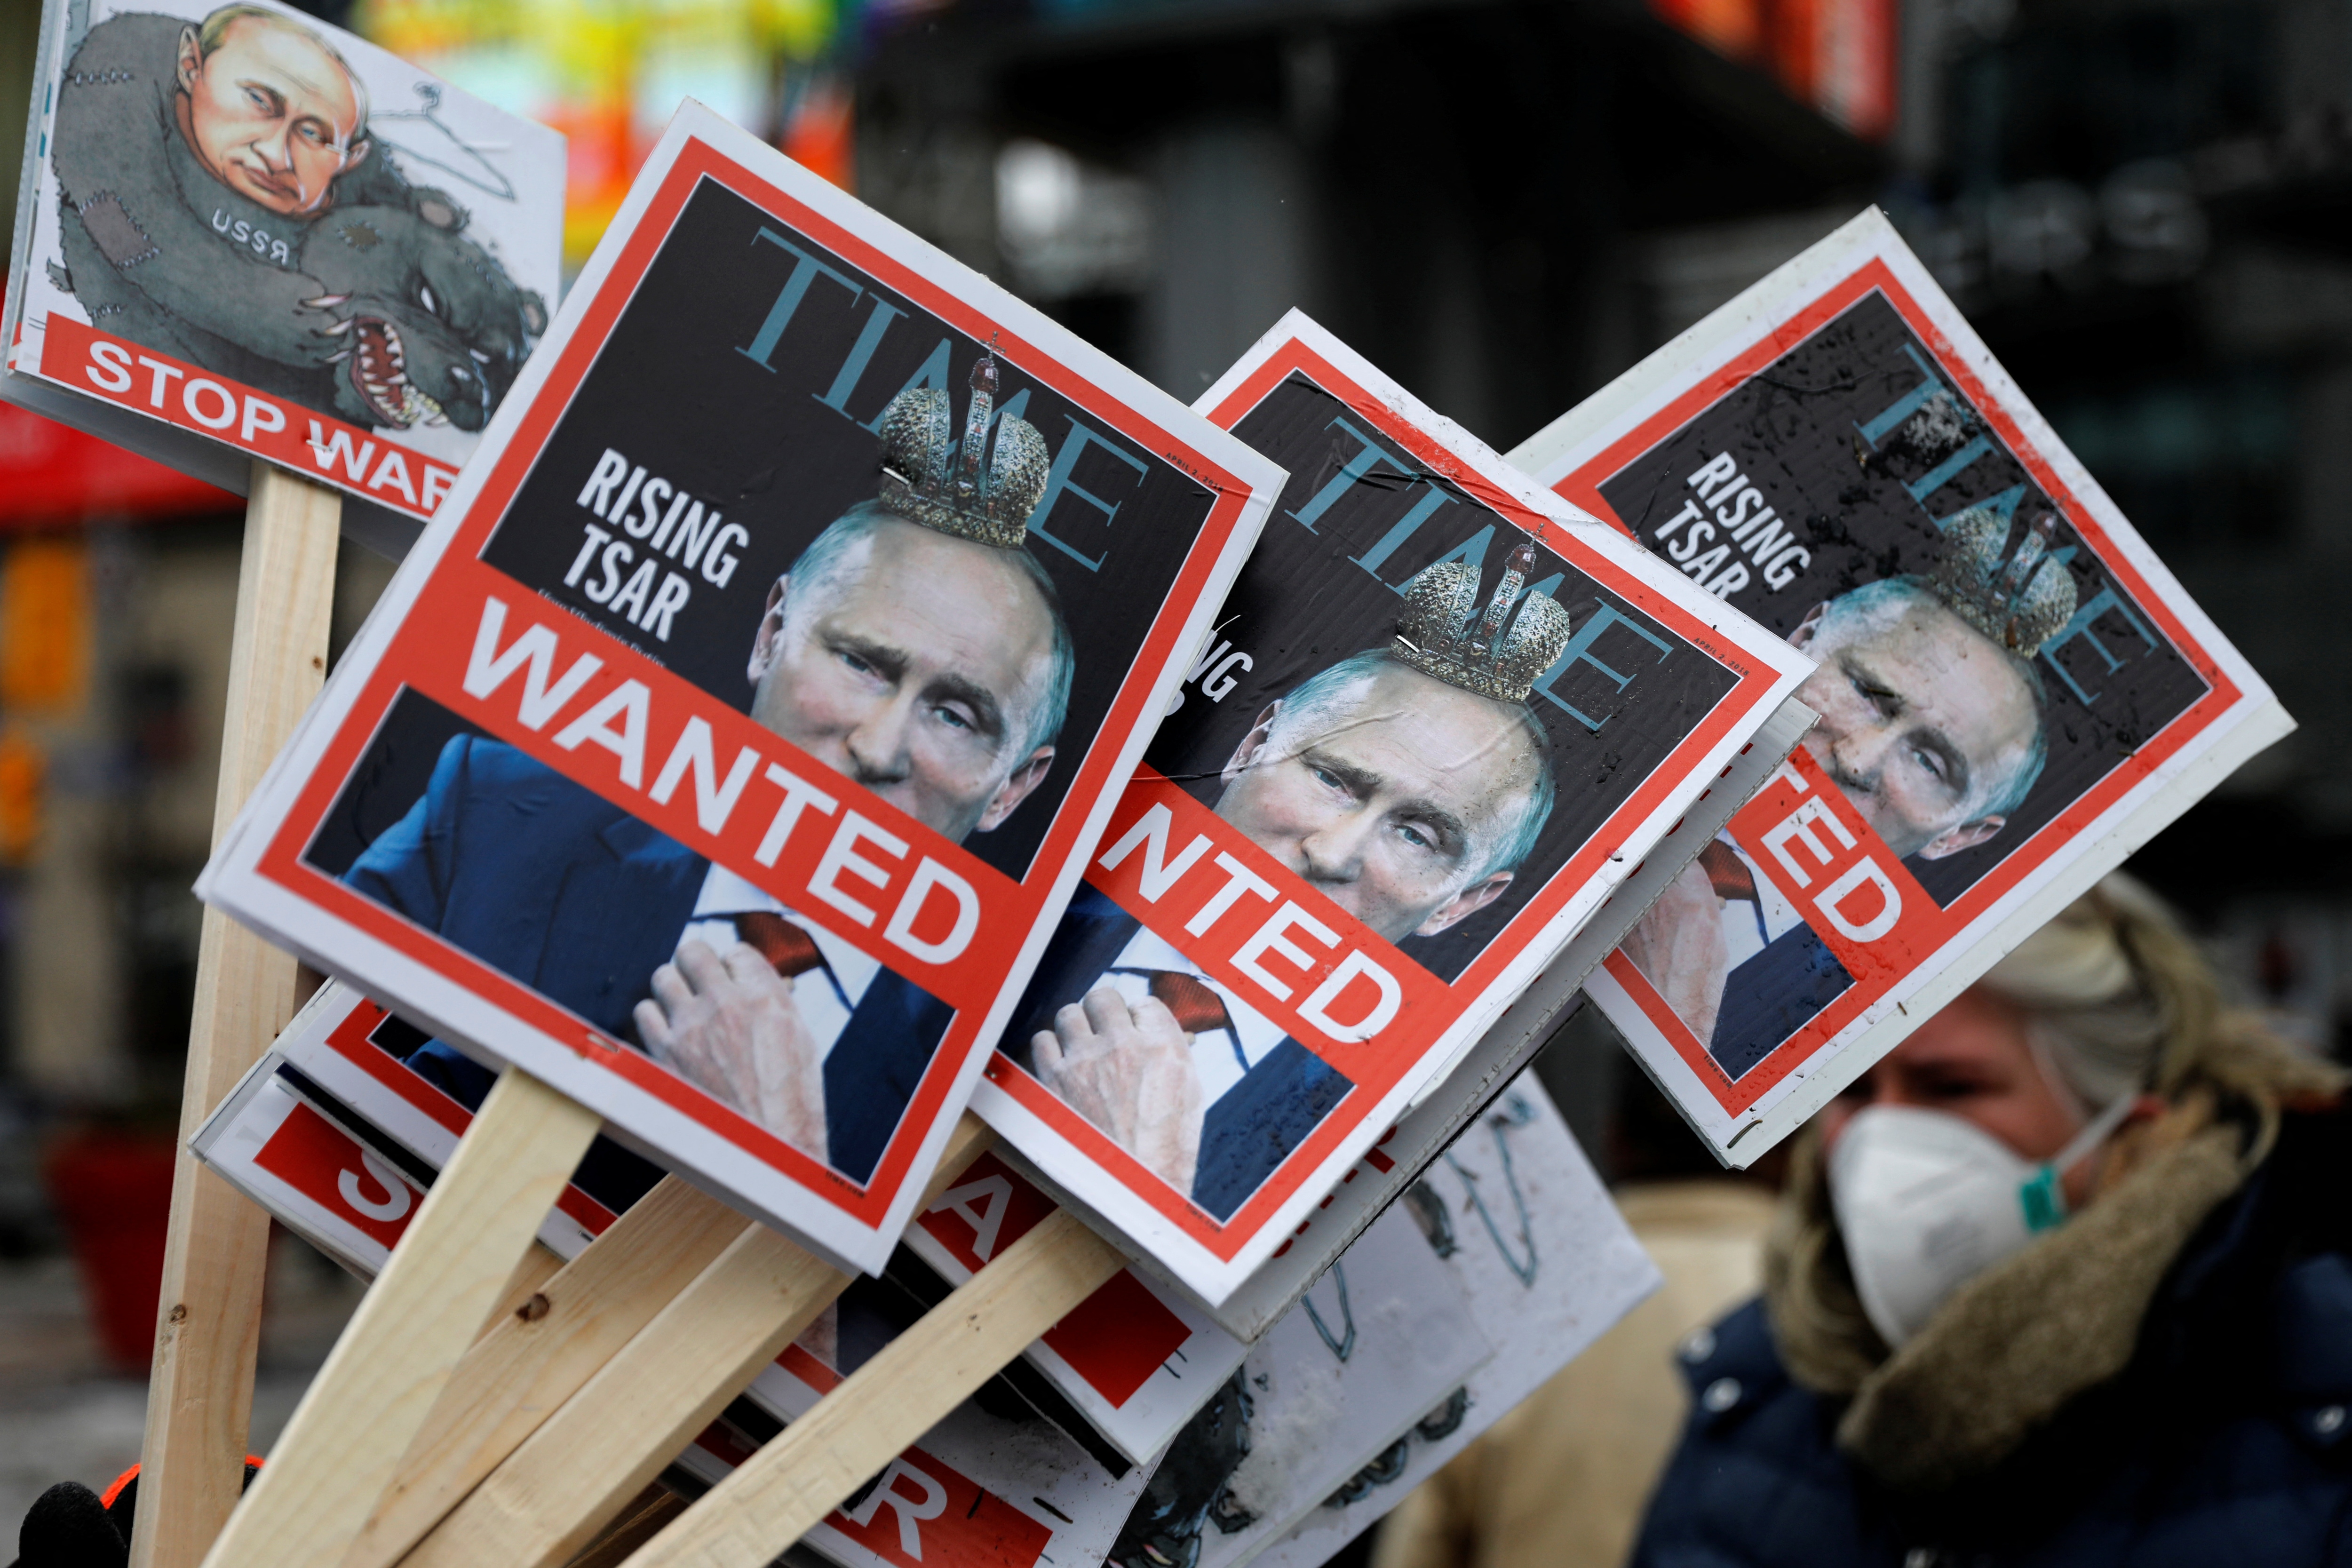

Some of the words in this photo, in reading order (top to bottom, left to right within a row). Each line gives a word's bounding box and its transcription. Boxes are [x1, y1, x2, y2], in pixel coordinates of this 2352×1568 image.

[85, 340, 286, 442] STOP
[576, 448, 750, 589] RISING
[1166, 452, 1189, 470] APRIL
[1192, 469, 1200, 479] 2,
[1654, 498, 1750, 600] TSAR
[1686, 450, 1811, 592] RISING
[563, 523, 691, 642] TSAR
[1694, 637, 1717, 654] APRIL
[1719, 654, 1725, 662] 2,
[1729, 661, 1749, 676] 2018
[462, 595, 980, 965] WANTED
[1097, 802, 1402, 1044] NTED
[1704, 1054, 1732, 1089] time.com
